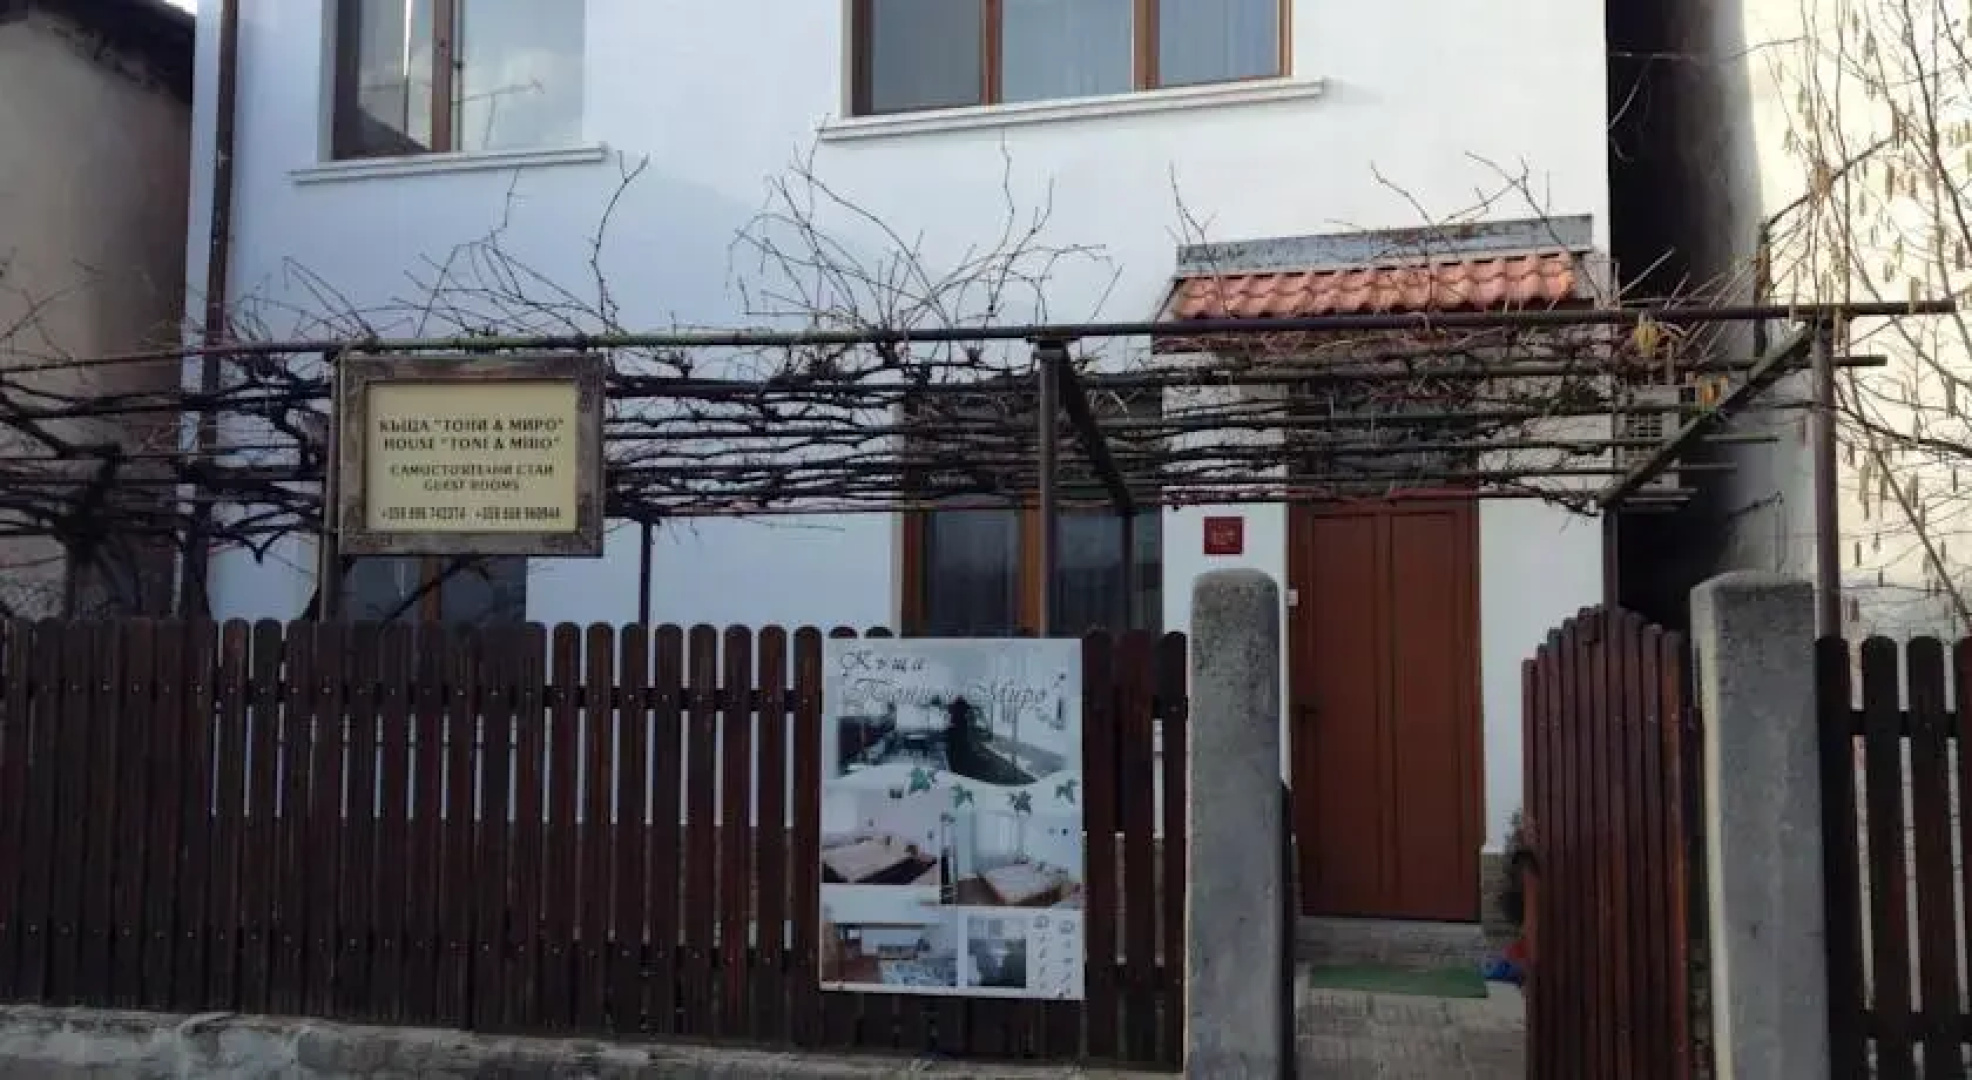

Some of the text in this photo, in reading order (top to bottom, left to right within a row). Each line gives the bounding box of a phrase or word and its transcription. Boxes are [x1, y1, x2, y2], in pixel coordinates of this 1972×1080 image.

[380, 419, 430, 432] КЪЩА
[493, 420, 503, 432] &
[384, 438, 433, 450] HOUSE
[494, 438, 503, 450] &
[516, 464, 554, 476] СТАИ
[424, 479, 519, 491] GUEST ROOMS
